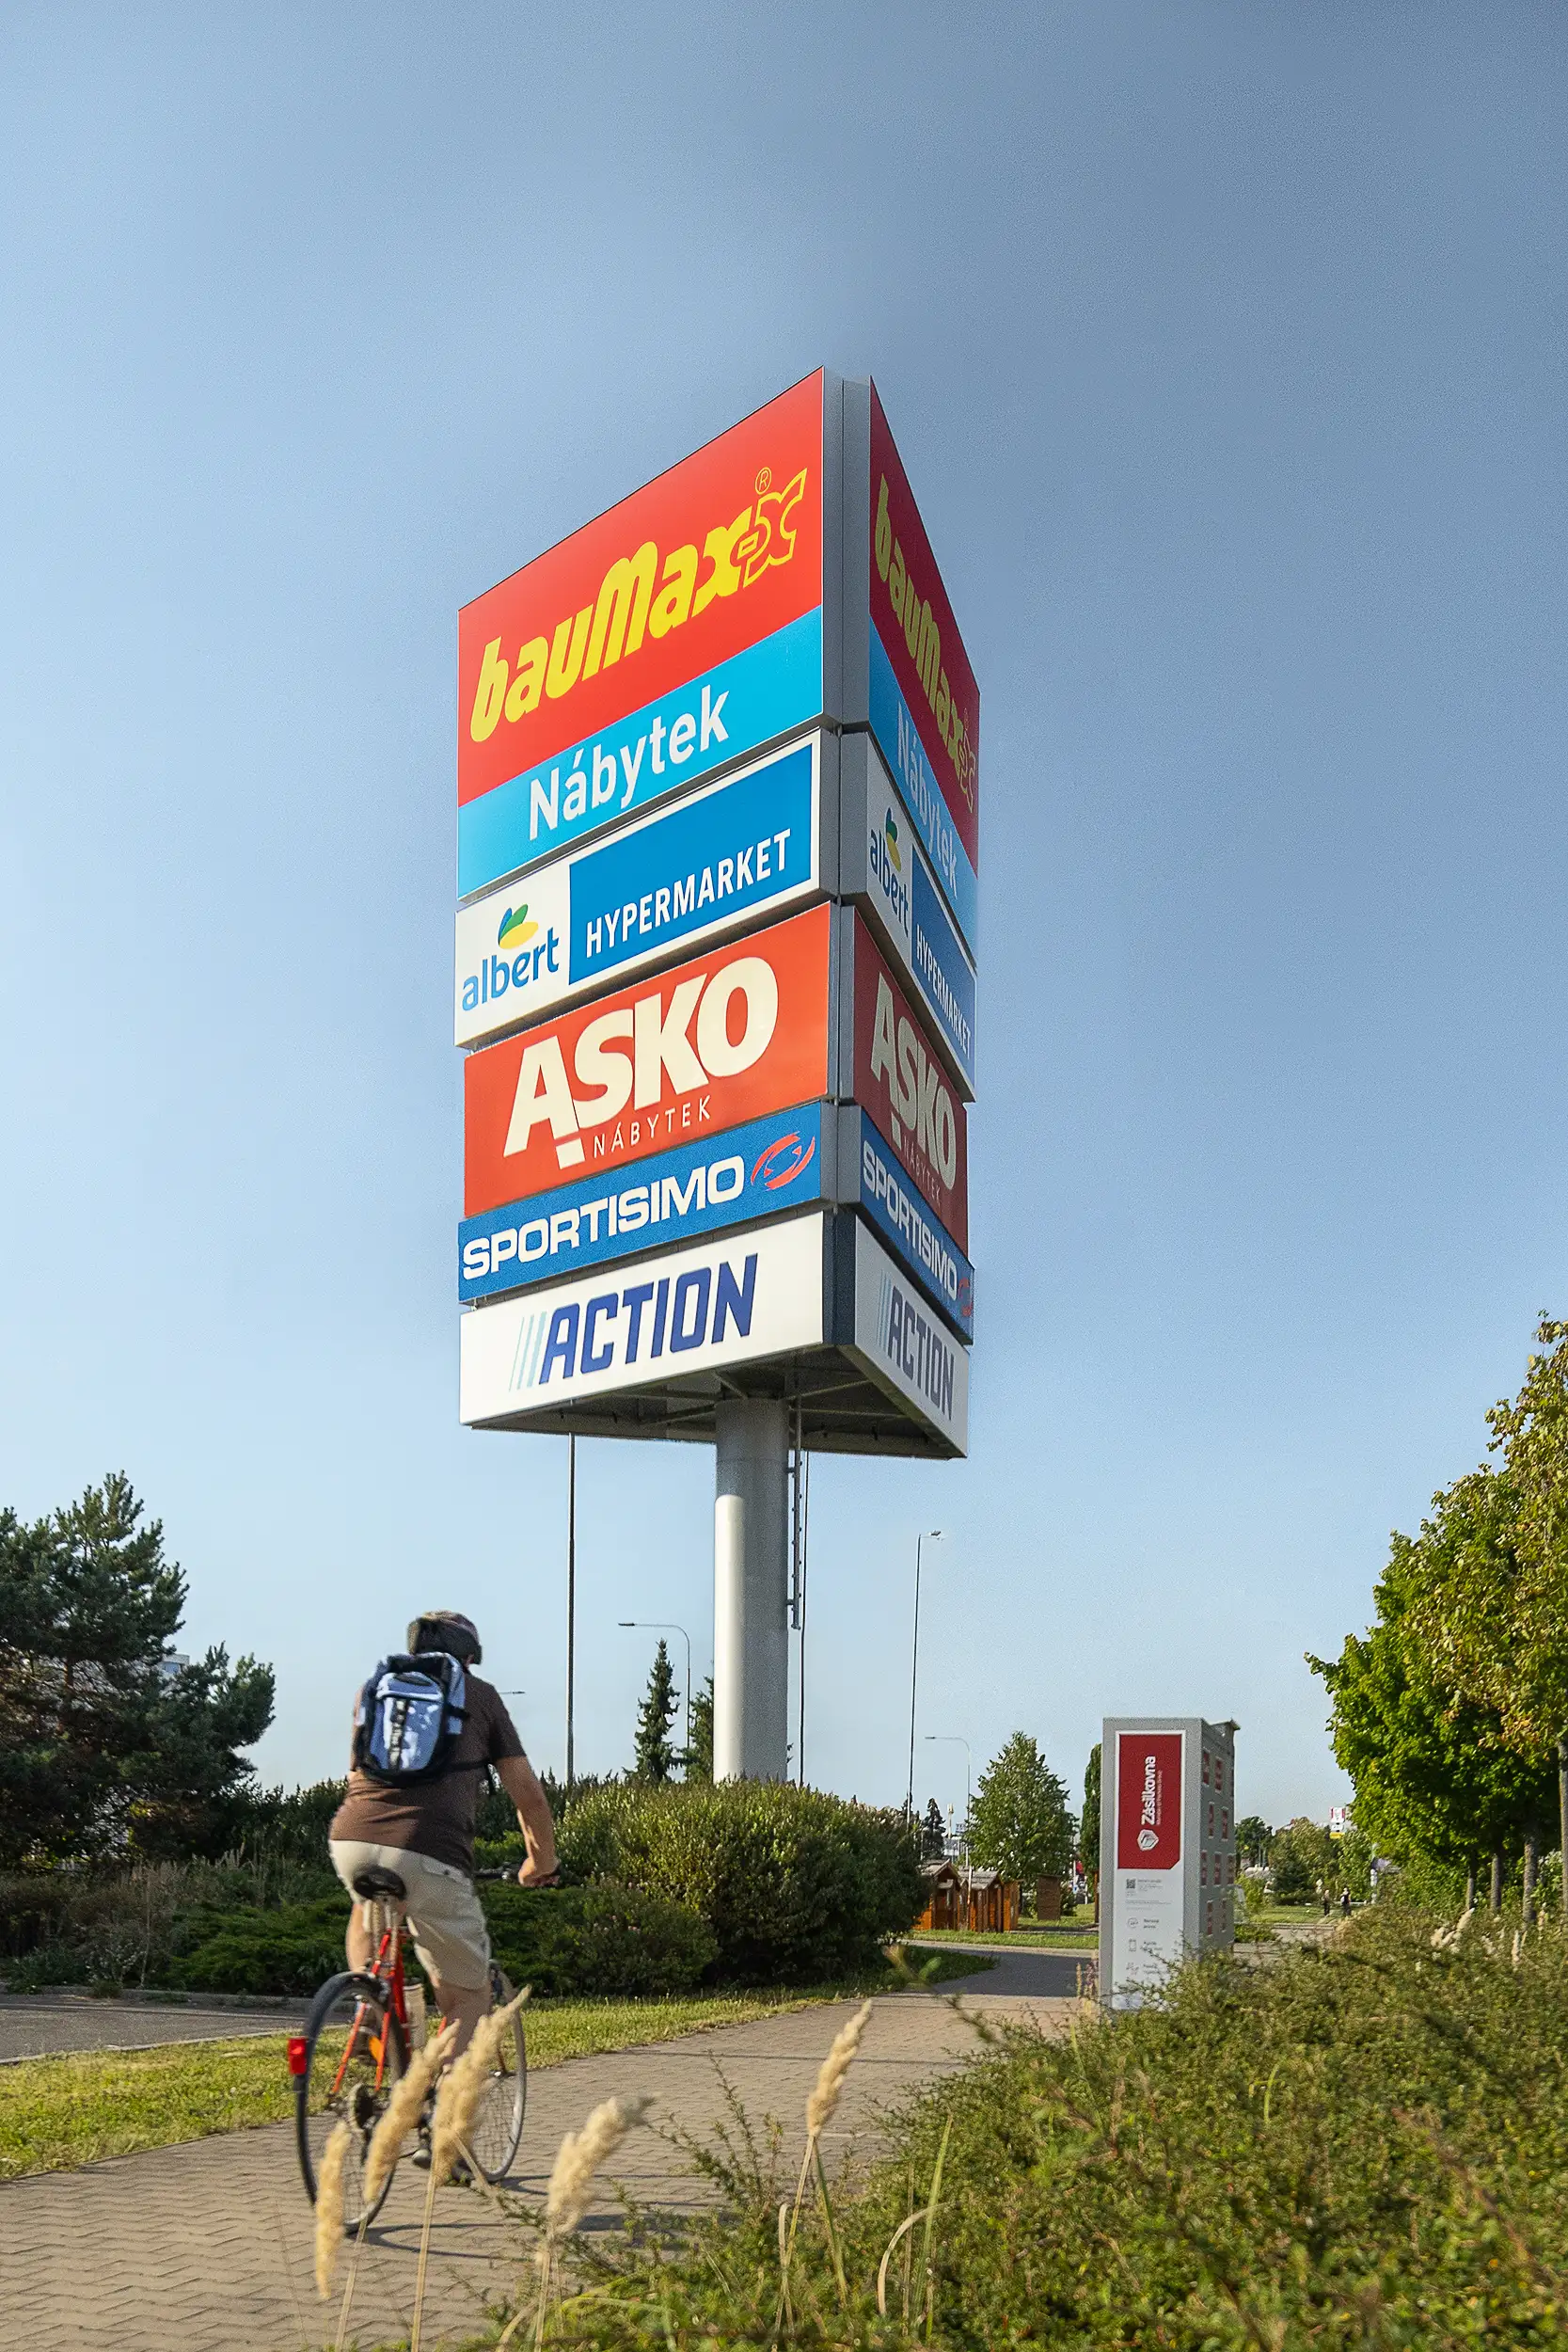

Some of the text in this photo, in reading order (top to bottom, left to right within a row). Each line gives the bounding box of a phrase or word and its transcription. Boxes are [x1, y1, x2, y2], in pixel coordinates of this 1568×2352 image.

[529, 684, 729, 842] Nábytek
[898, 699, 958, 900] Nábytek
[462, 828, 792, 1011] albert HYPERMARKET
[870, 828, 972, 1060] albert HYPERMARKET
[503, 956, 779, 1170] ASKO
[593, 1095, 712, 1159] NÁBYTEK
[870, 972, 957, 1190] ASKO
[462, 1155, 745, 1280] SPORTISIMO
[863, 1138, 958, 1302] SPORTISIMO
[539, 1252, 758, 1386] ACTION
[887, 1282, 956, 1422] ACTION
